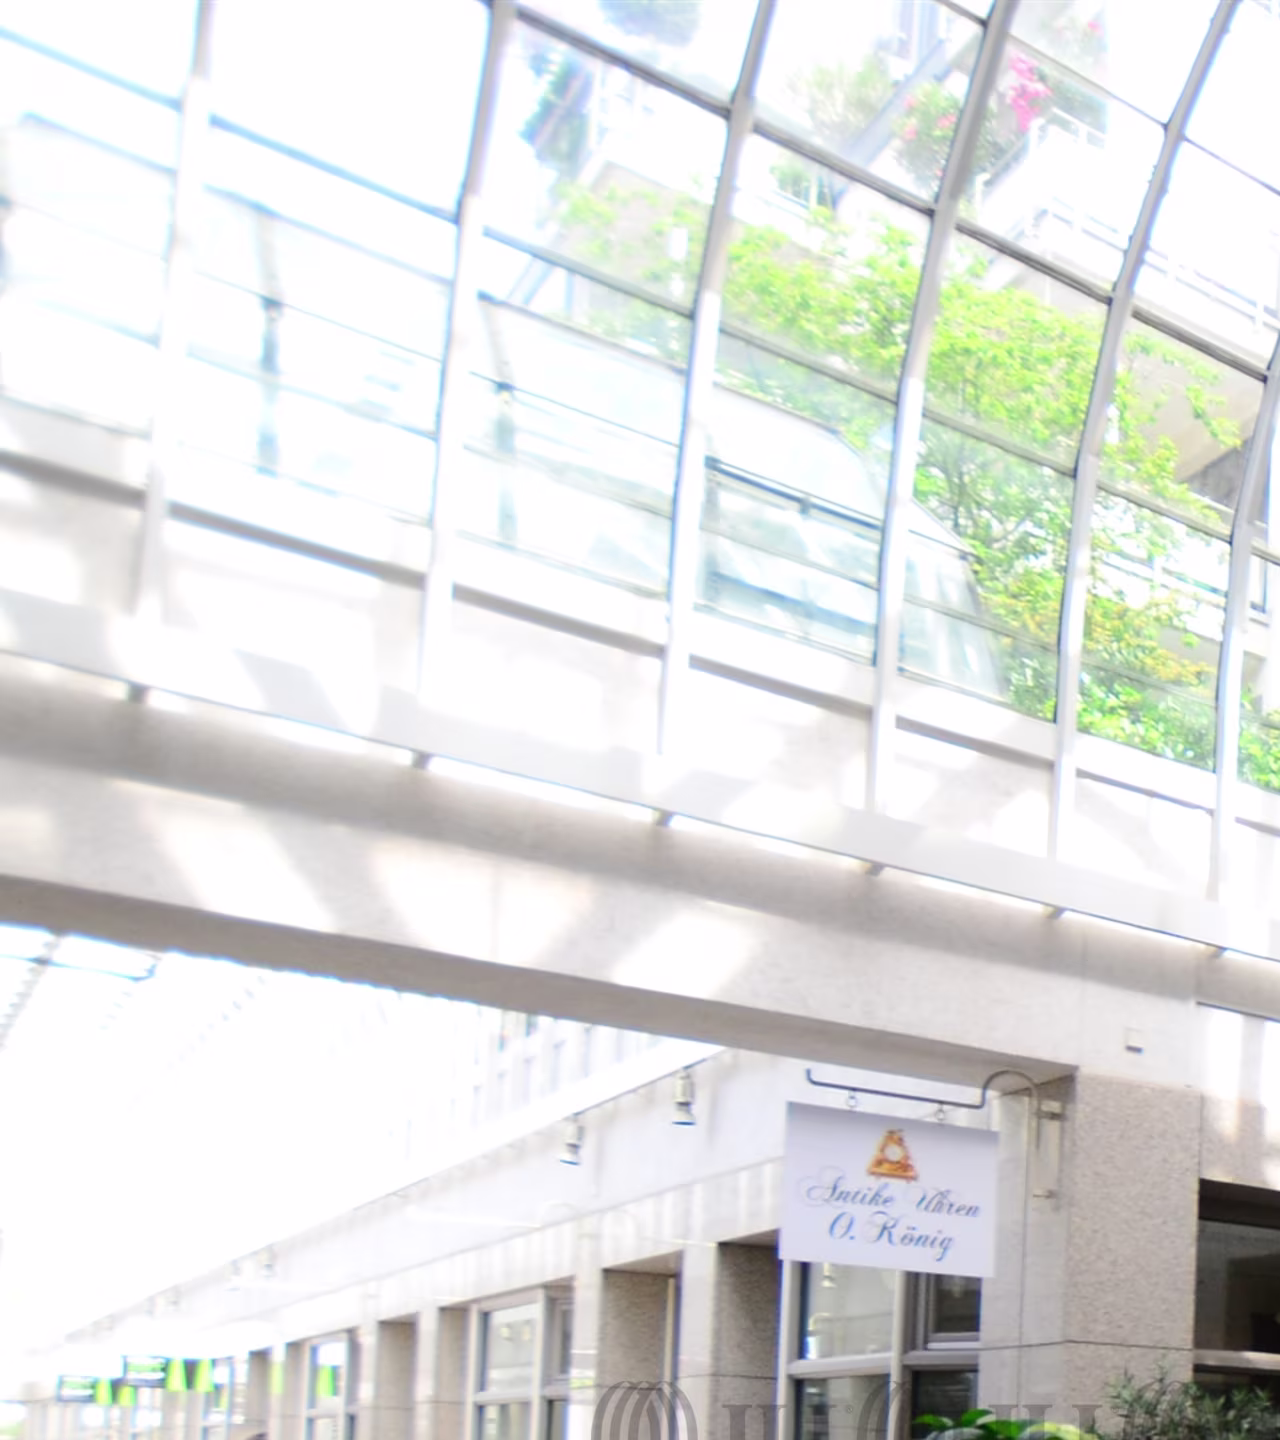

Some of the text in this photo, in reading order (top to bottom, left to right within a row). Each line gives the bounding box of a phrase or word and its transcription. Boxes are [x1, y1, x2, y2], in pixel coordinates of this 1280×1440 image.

[799, 1168, 981, 1218] Antike Uhren
[828, 1211, 955, 1262] O. König
